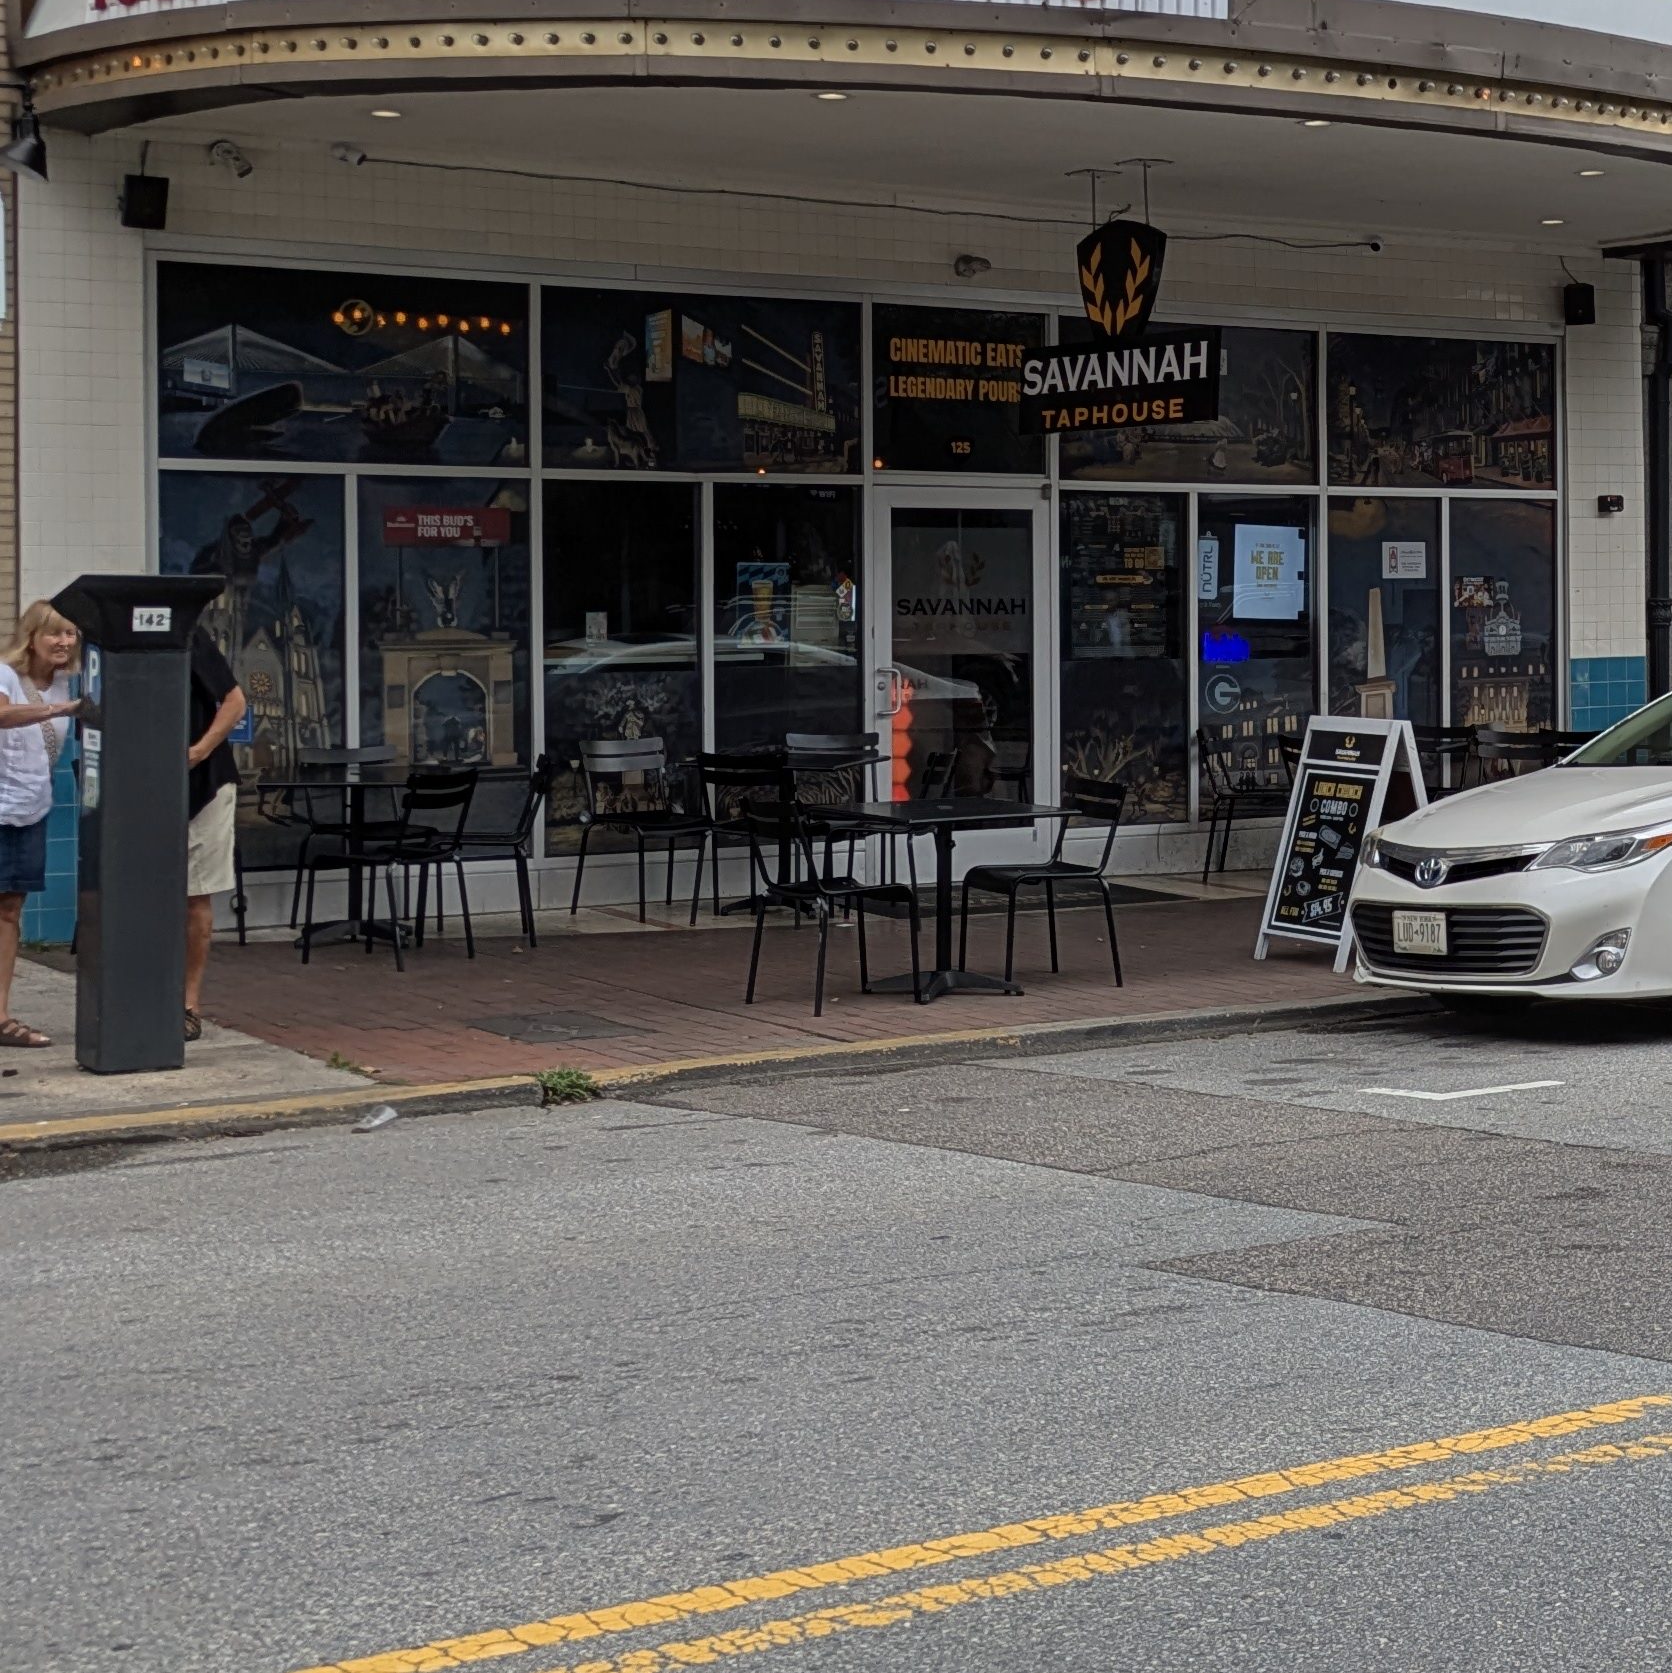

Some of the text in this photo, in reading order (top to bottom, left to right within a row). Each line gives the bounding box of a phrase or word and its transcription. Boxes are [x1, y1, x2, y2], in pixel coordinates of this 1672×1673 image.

[889, 337, 981, 366] CINEMATIC
[1023, 341, 1209, 396] SAVANNAH
[889, 375, 975, 401] LEGENDARY
[1042, 398, 1184, 429] TAPHOUSE
[950, 440, 972, 455] 125
[416, 514, 440, 526] THIS
[443, 514, 475, 526] BUD'S
[417, 527, 438, 538] FOR
[440, 527, 461, 538] YOU
[1250, 550, 1265, 565] WE
[1255, 566, 1279, 581] OPEN
[896, 598, 1026, 616] SAVANNAH
[139, 613, 167, 627] 142
[1320, 798, 1349, 816] COMBO
